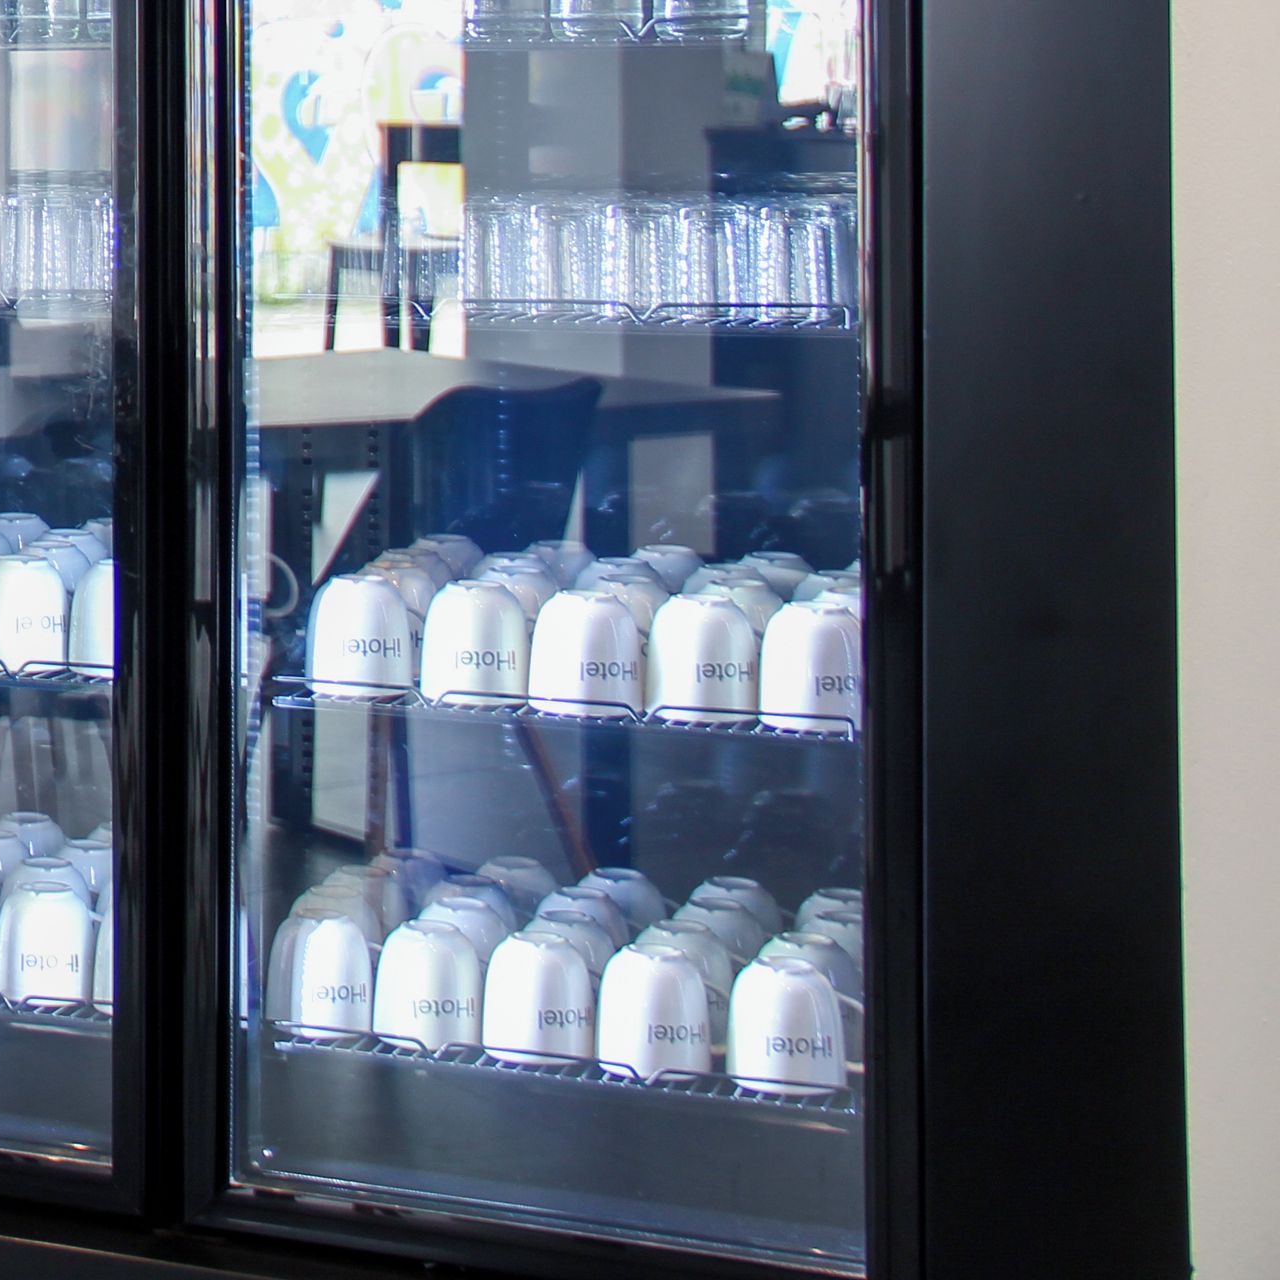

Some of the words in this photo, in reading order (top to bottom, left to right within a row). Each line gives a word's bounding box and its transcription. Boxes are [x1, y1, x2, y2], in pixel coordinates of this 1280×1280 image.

[342, 638, 401, 659] iHotel
[456, 650, 517, 672] iHotel
[581, 661, 639, 682] iHotel
[696, 660, 754, 684] iHotel
[815, 675, 857, 697] otel
[413, 997, 475, 1020] iHotel
[538, 1006, 592, 1031] iHotel
[648, 1021, 705, 1045] iHotel
[766, 1036, 833, 1060] iHotel
